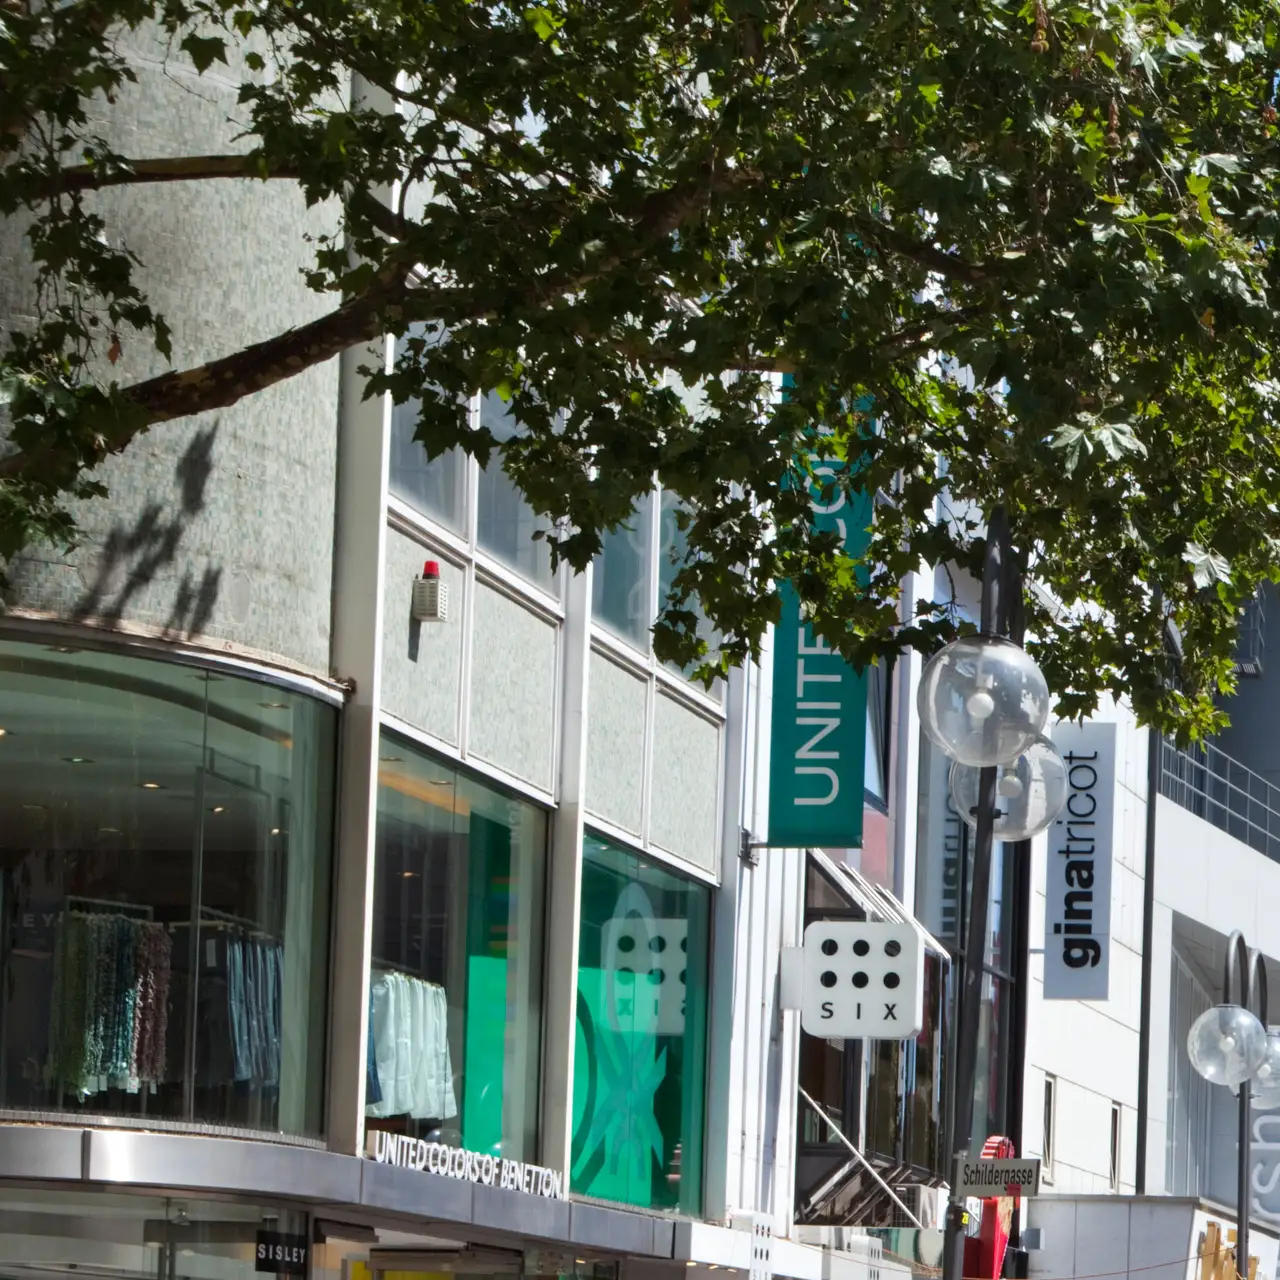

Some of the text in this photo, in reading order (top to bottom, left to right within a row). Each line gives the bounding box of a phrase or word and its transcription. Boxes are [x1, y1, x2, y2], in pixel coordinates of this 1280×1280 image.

[793, 601, 842, 806] UNITE
[1053, 750, 1102, 968] ginatricot
[820, 1001, 898, 1021] SIX
[375, 1130, 427, 1171] UNITED
[428, 1142, 481, 1184] COLORS
[481, 1155, 500, 1186] OF
[962, 1163, 1033, 1191] Schildergasse
[257, 1243, 306, 1264] SISLEY
